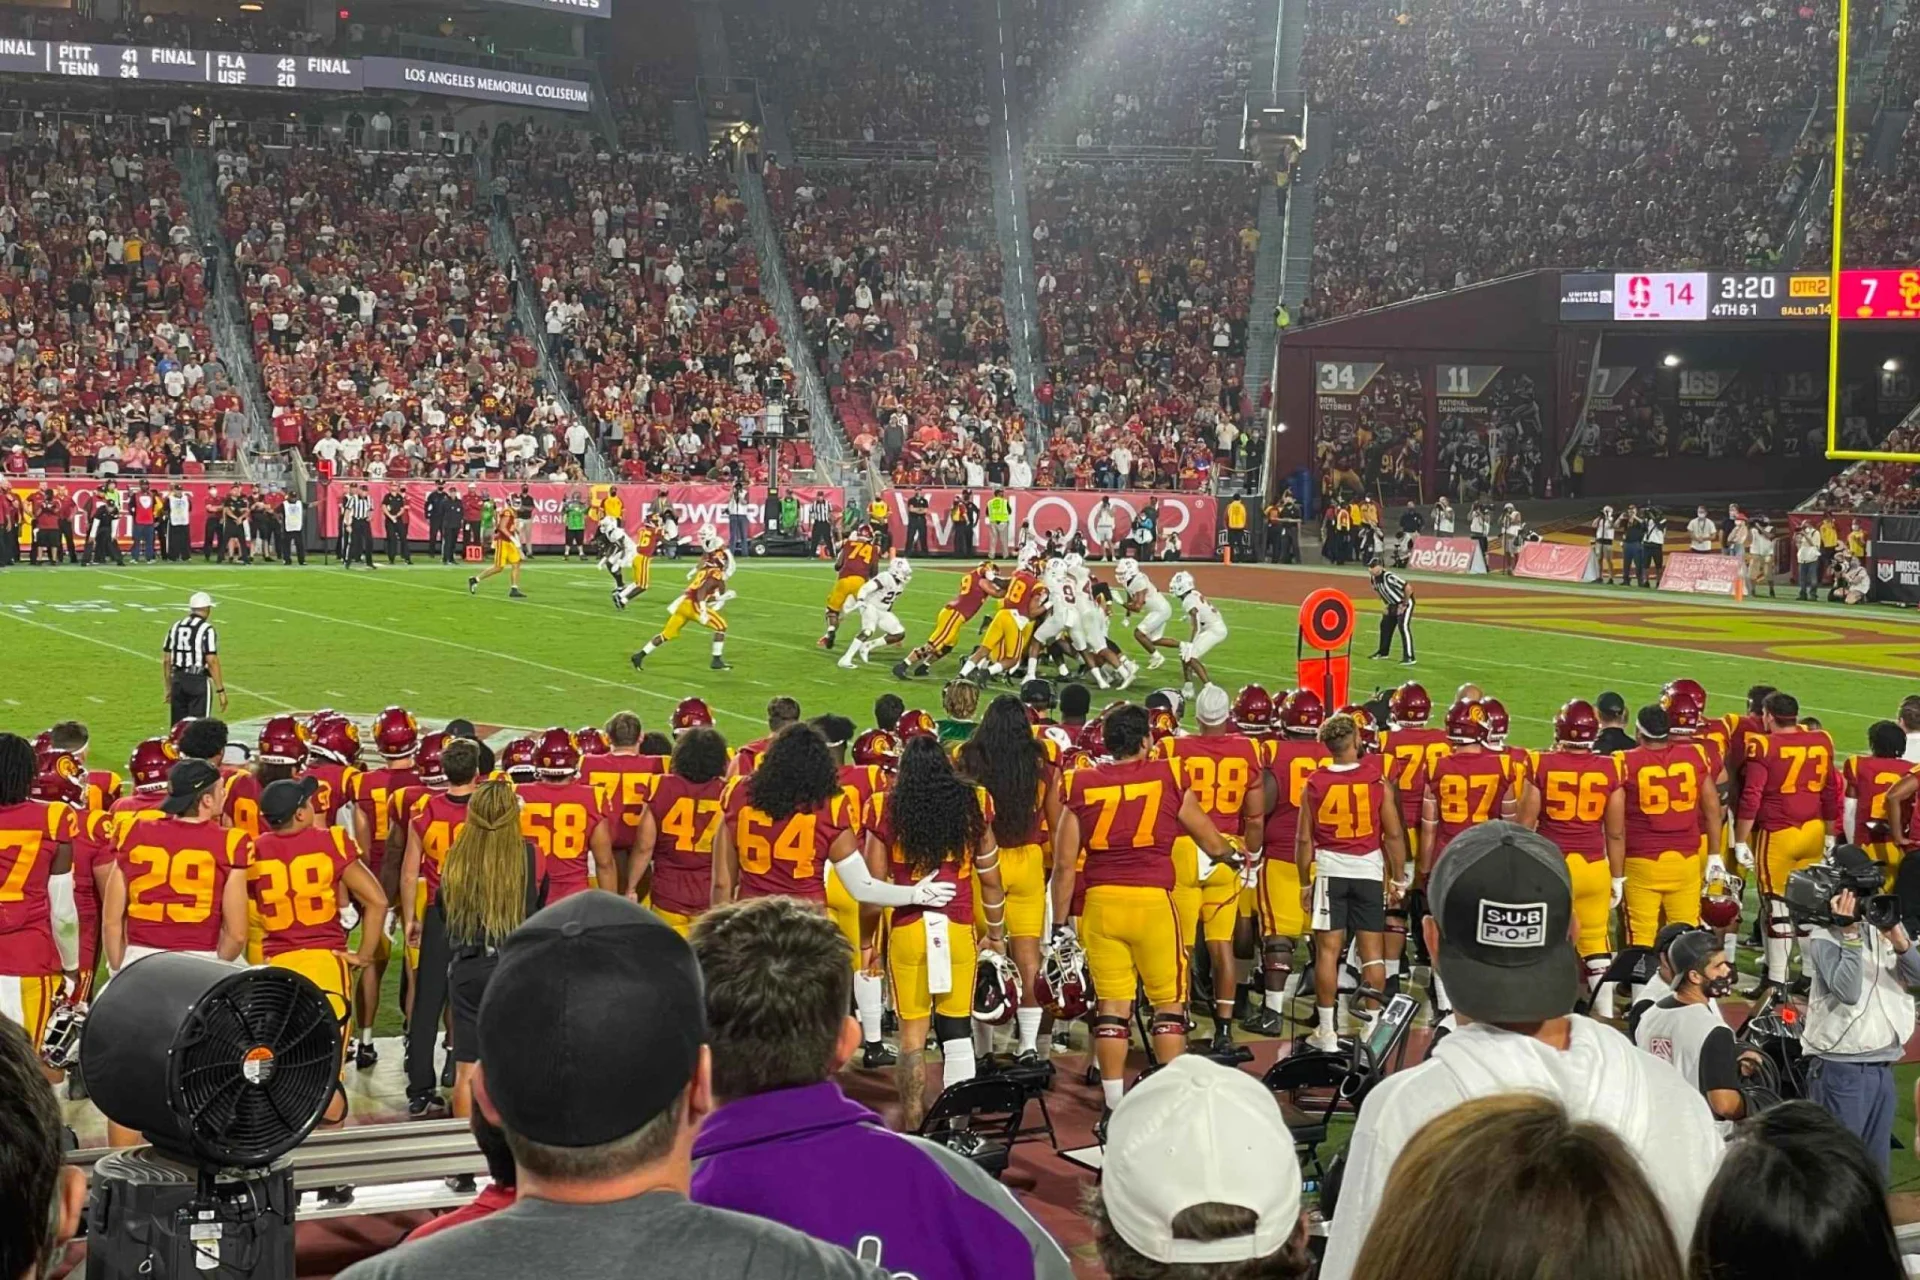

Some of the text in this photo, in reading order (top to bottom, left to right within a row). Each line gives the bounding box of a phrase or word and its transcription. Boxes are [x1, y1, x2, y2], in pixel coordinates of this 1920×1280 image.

[59, 45, 196, 65] PITT 41 FINAL
[217, 54, 351, 74] FLA 42 FINAL
[58, 61, 139, 79] TENN 34
[217, 70, 296, 87] USF 20
[404, 67, 588, 102] LOS ANGELES MEMORIAL COLISEUM
[1664, 282, 1694, 306] 14
[1721, 276, 1775, 299] 3:20
[1860, 278, 1878, 305] 7
[1711, 303, 1737, 316] 4TH
[1781, 306, 1804, 316] BALL
[1805, 306, 1818, 316] ON
[1321, 363, 1355, 390] 34
[1447, 366, 1471, 393] 11
[1319, 403, 1352, 411] VICTORIES
[1461, 453, 1479, 470] 42
[468, 547, 481, 560] 10
[848, 541, 873, 565] 74
[1410, 541, 1471, 569] nextiva
[177, 627, 192, 651] R
[1779, 745, 1828, 794] 73
[589, 772, 653, 826] 75
[1185, 757, 1248, 814] 88
[1439, 774, 1500, 823] 87
[1546, 771, 1608, 821] 56
[1637, 762, 1697, 815] 63
[1083, 780, 1163, 850] 77
[1318, 784, 1374, 838] 41
[519, 802, 588, 859] 58
[661, 797, 723, 853] 47
[736, 806, 817, 879] 64
[127, 844, 216, 923] 29
[246, 852, 337, 932] 38
